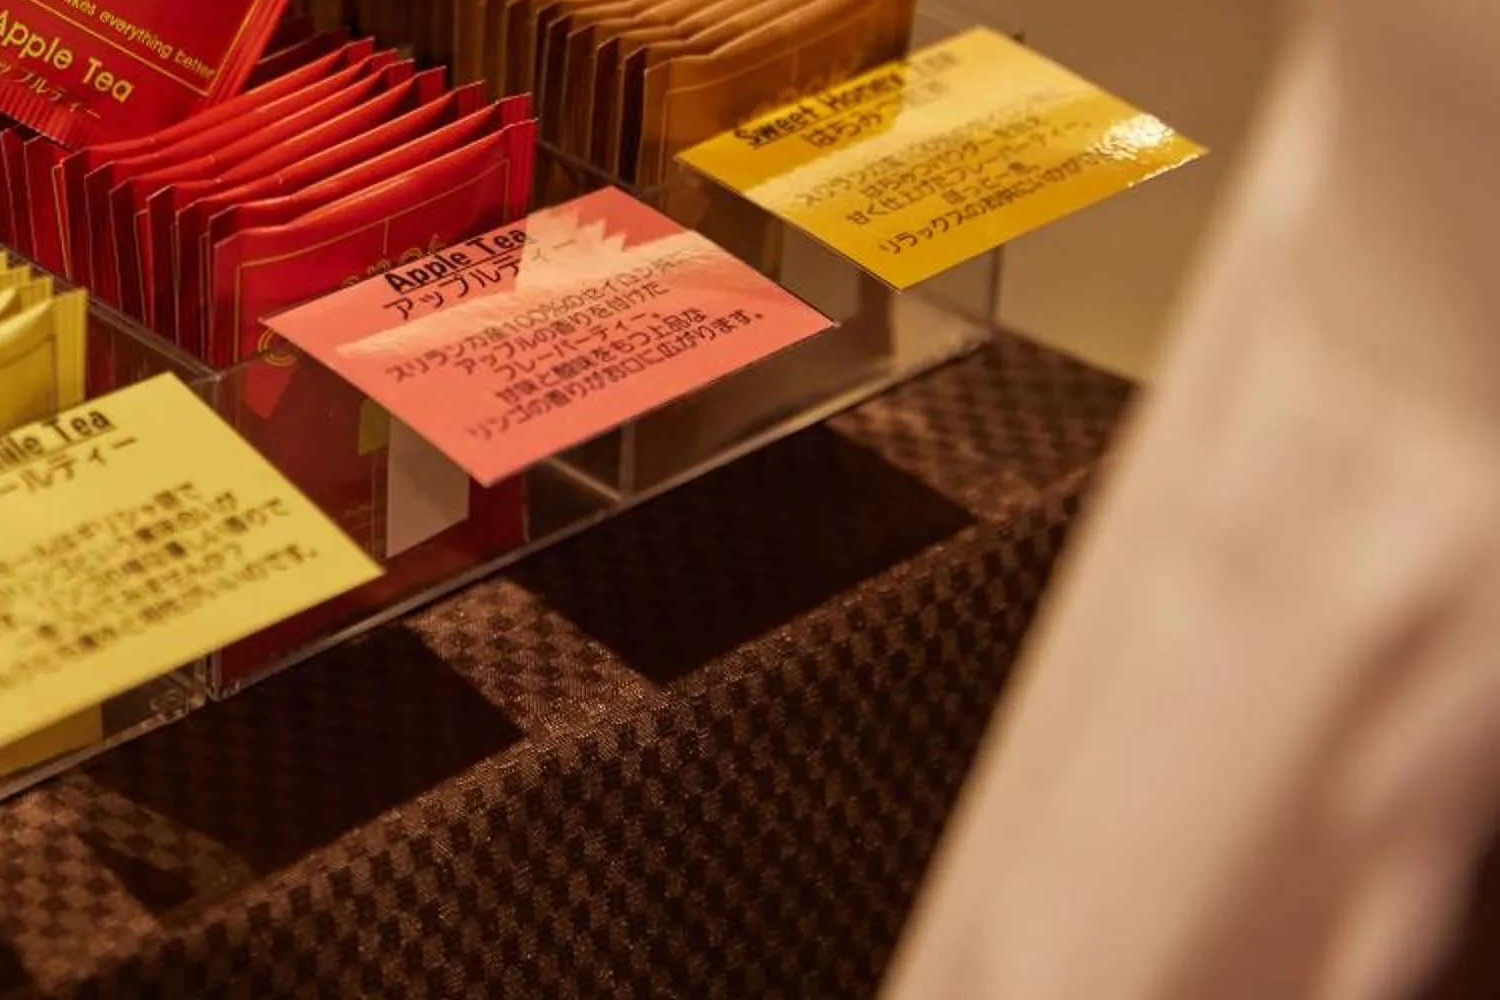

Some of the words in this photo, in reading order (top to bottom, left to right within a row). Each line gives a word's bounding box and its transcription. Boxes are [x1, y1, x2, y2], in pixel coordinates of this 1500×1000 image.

[99, 8, 174, 60] everything
[173, 49, 216, 78] better
[82, 55, 136, 103] Tea
[733, 105, 819, 149] Sweet
[382, 238, 578, 321] アップルティー
[384, 251, 472, 293] Apple
[464, 222, 530, 257] Tea
[43, 409, 112, 445] Tea
